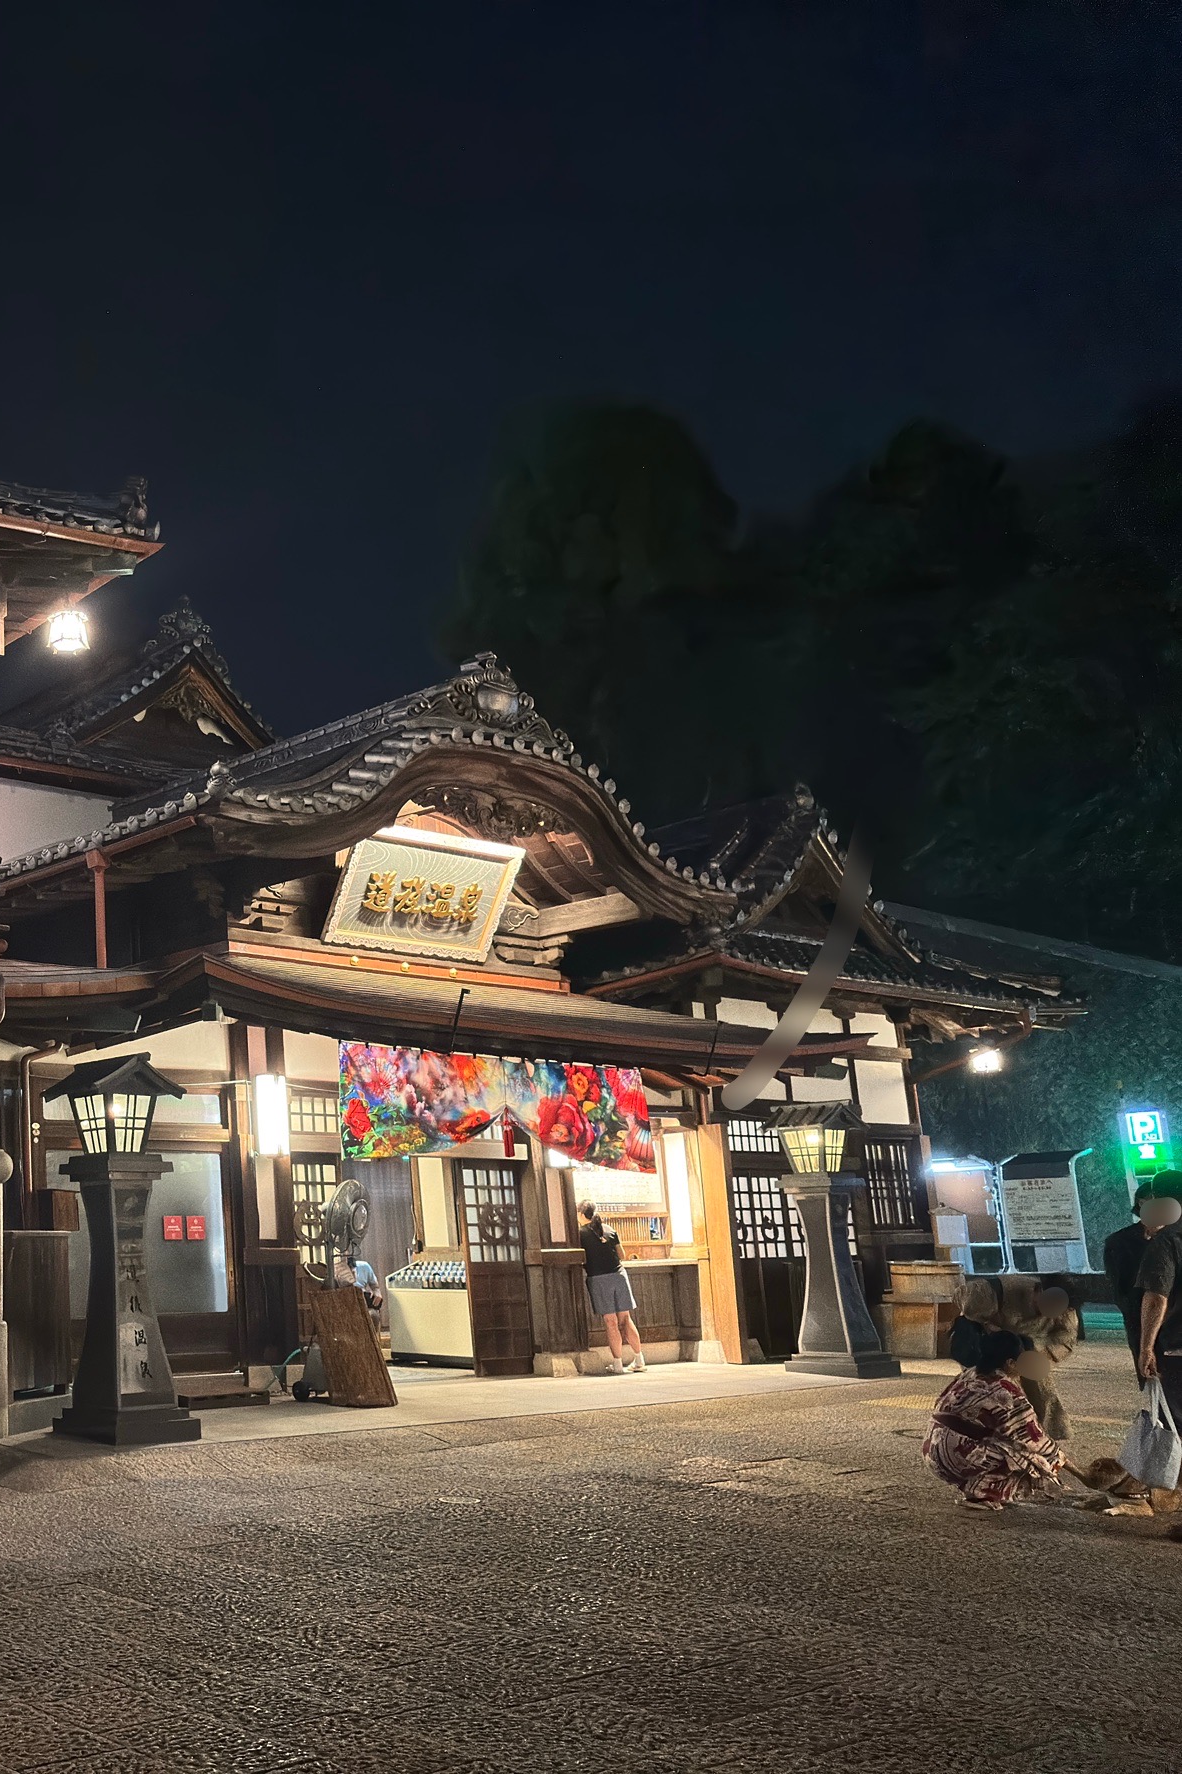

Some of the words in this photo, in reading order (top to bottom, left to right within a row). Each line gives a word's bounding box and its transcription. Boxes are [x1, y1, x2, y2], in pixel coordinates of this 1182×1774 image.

[362, 871, 483, 923] 道後温泉
[1132, 1113, 1155, 1142] P
